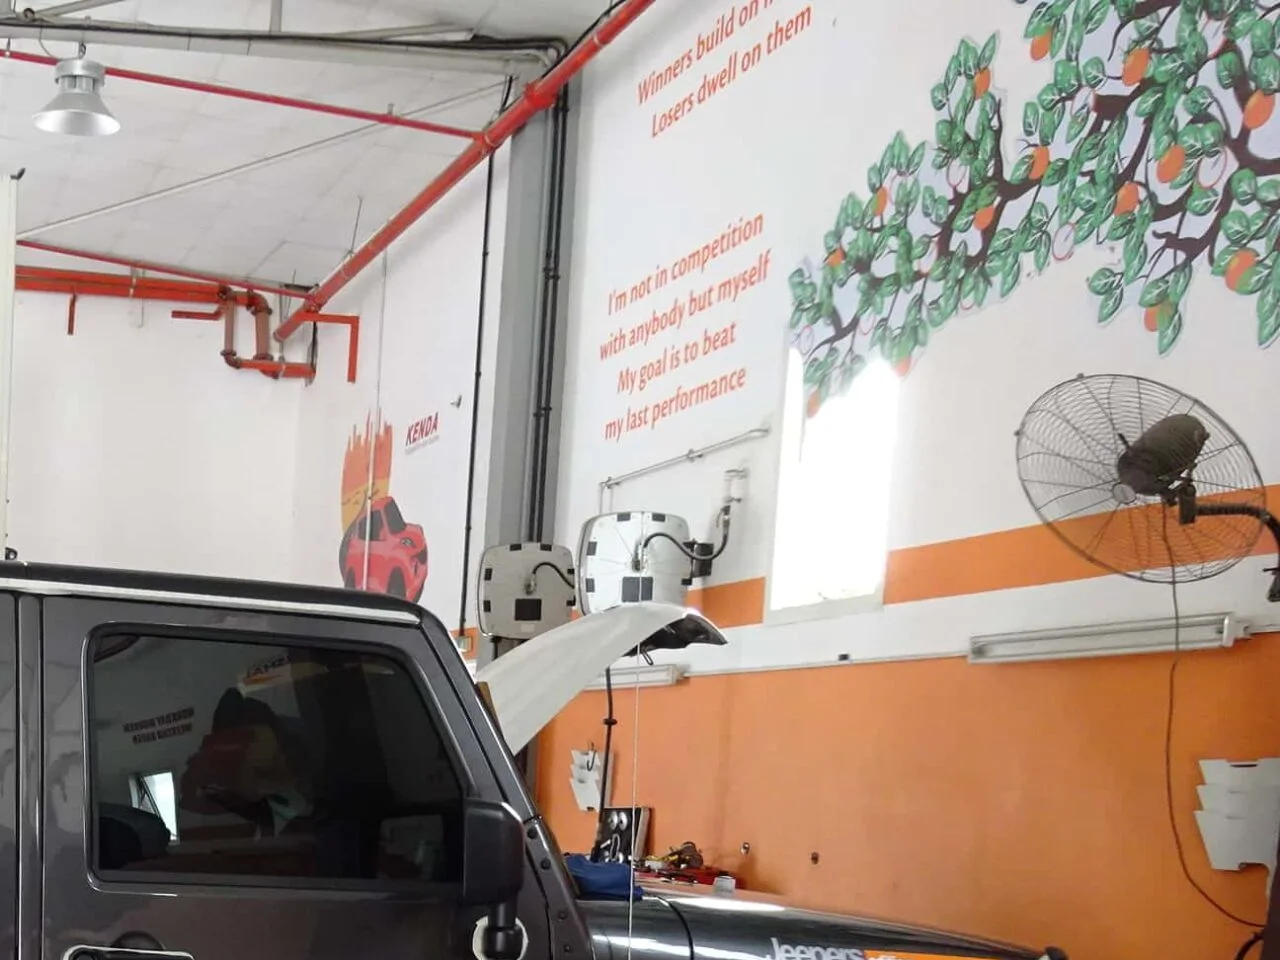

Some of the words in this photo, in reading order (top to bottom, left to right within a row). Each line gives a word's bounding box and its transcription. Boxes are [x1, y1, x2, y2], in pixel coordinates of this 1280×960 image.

[638, 49, 692, 105] Winners
[696, 6, 735, 61] build
[738, 0, 759, 27] on
[652, 92, 694, 138] Losers
[697, 51, 738, 104] dwell
[741, 43, 761, 72] on
[767, 6, 812, 55] them
[600, 328, 626, 361] with
[629, 298, 685, 346] anybody
[688, 290, 714, 317] but
[717, 248, 771, 302] myself
[608, 290, 627, 315] I'm
[630, 276, 651, 303] not
[655, 264, 668, 289] in
[671, 213, 764, 273] competition
[605, 417, 623, 442] my
[626, 406, 649, 432] last
[651, 368, 746, 429] performance
[617, 367, 637, 395] My
[639, 348, 667, 391] goal
[670, 345, 680, 370] is
[684, 341, 698, 363] to
[702, 322, 737, 356] beat
[405, 412, 438, 446] KENDA
